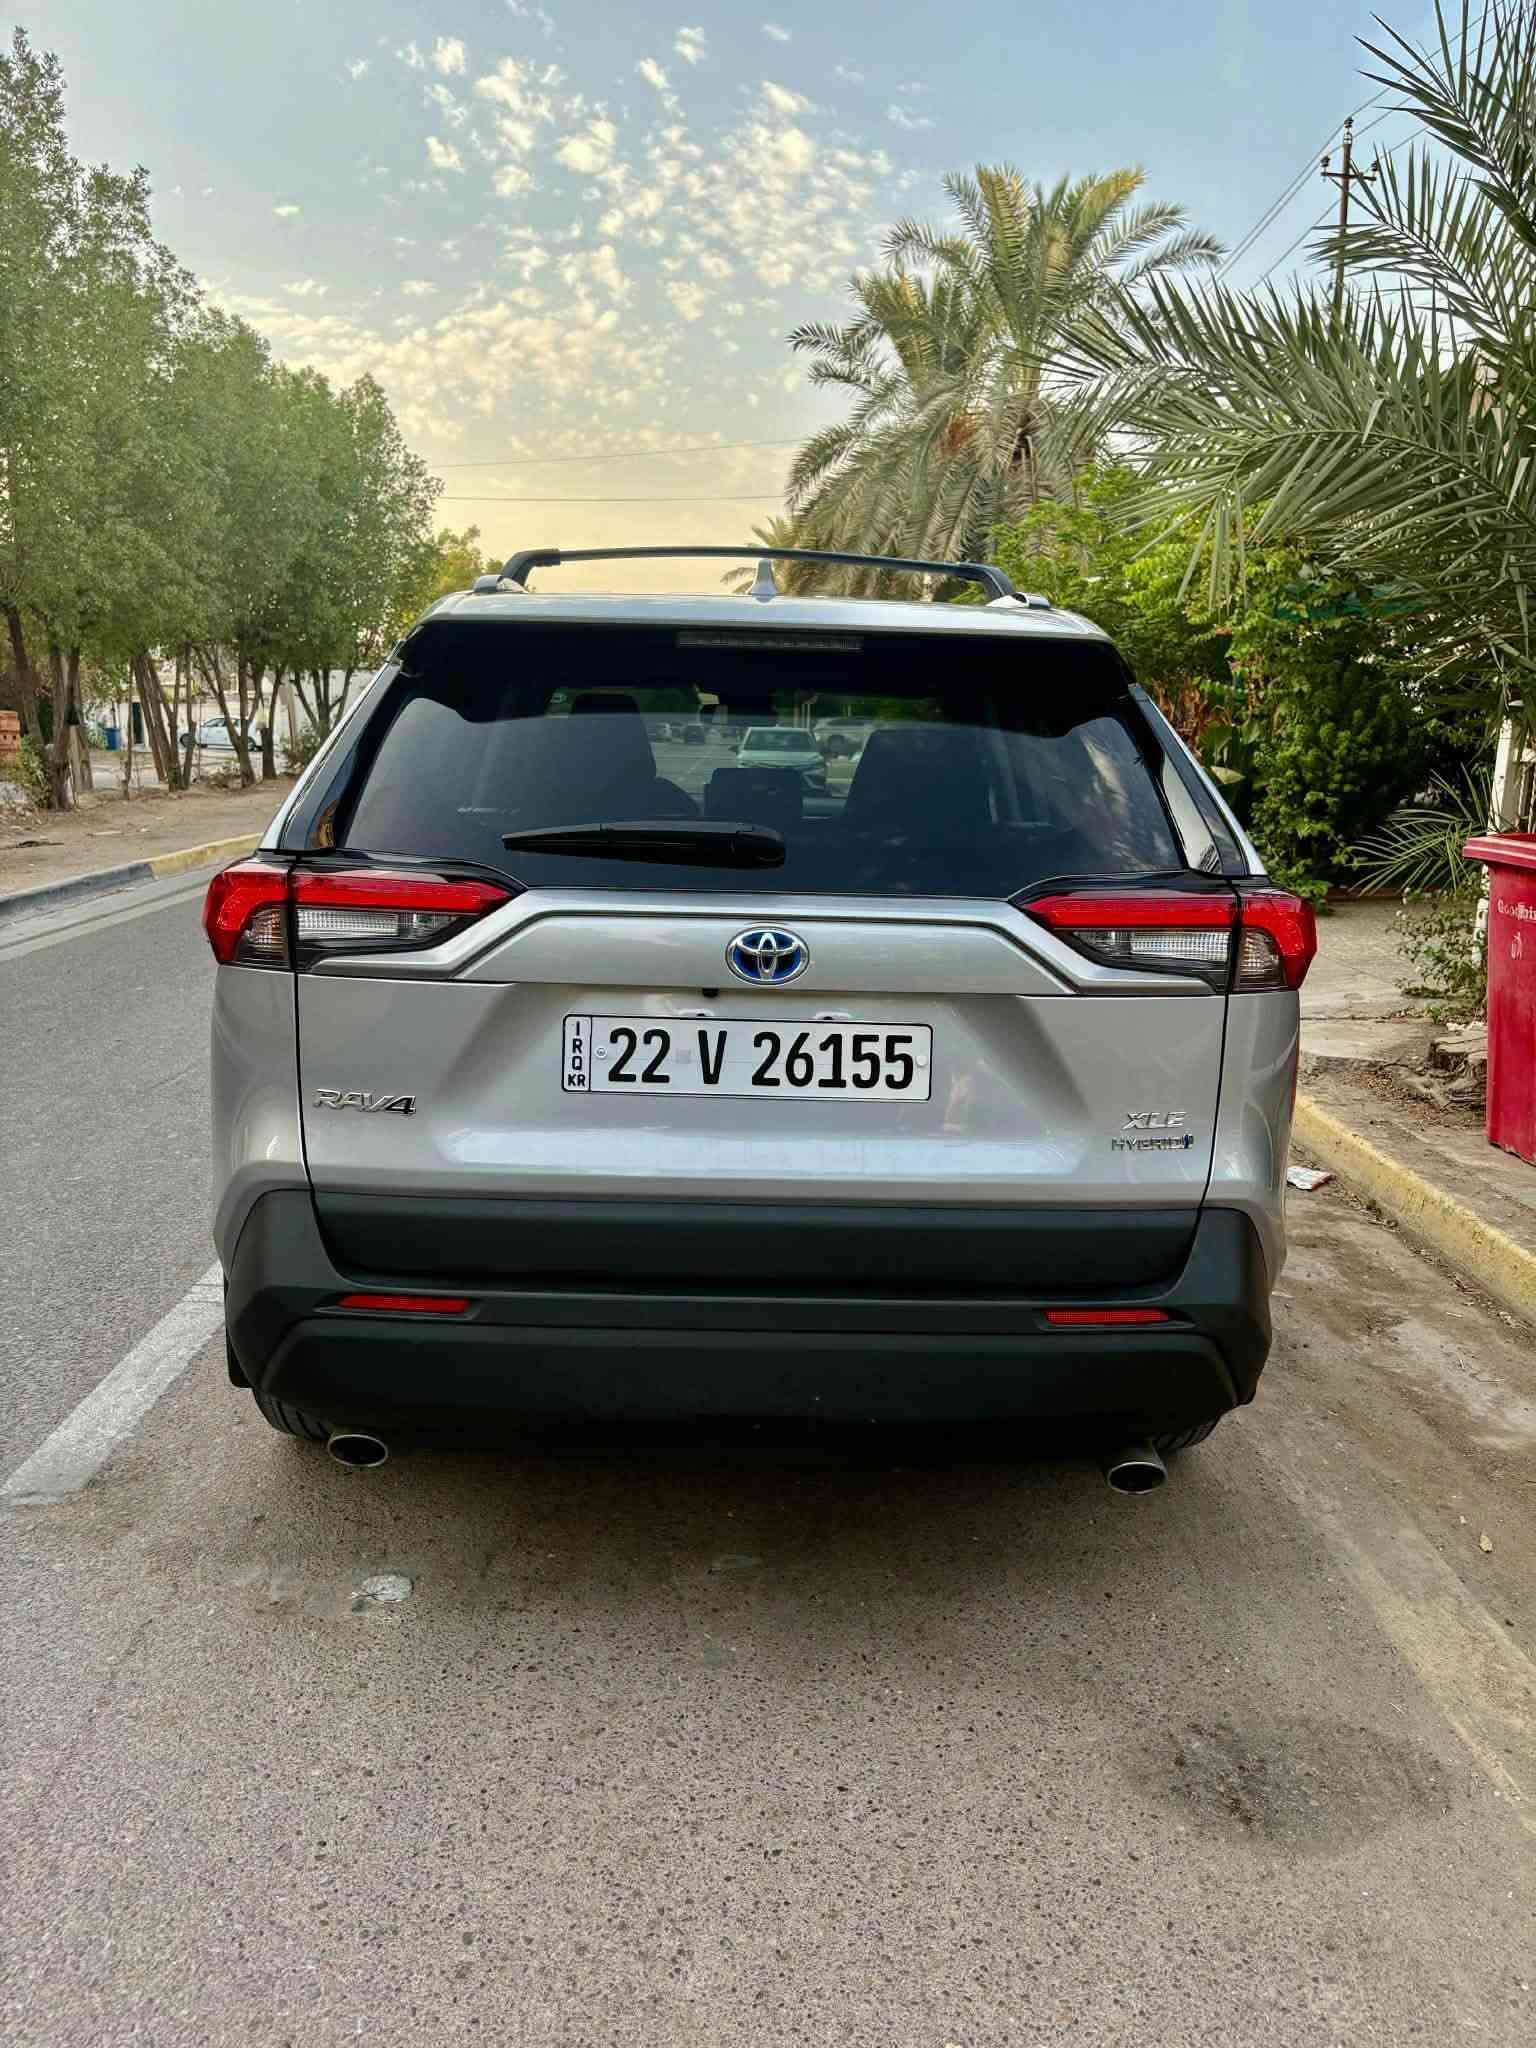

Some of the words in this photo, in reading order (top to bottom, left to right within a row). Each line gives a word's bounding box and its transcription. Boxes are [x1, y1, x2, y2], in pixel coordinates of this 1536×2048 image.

[571, 1020, 583, 1071] IRQ
[608, 1027, 671, 1083] 22
[697, 1029, 728, 1085] V
[751, 1031, 914, 1089] 26155
[567, 1073, 586, 1087] KR
[313, 1088, 416, 1114] RAV4
[1121, 1111, 1187, 1130] XLE
[1111, 1135, 1184, 1151] HYBRID
